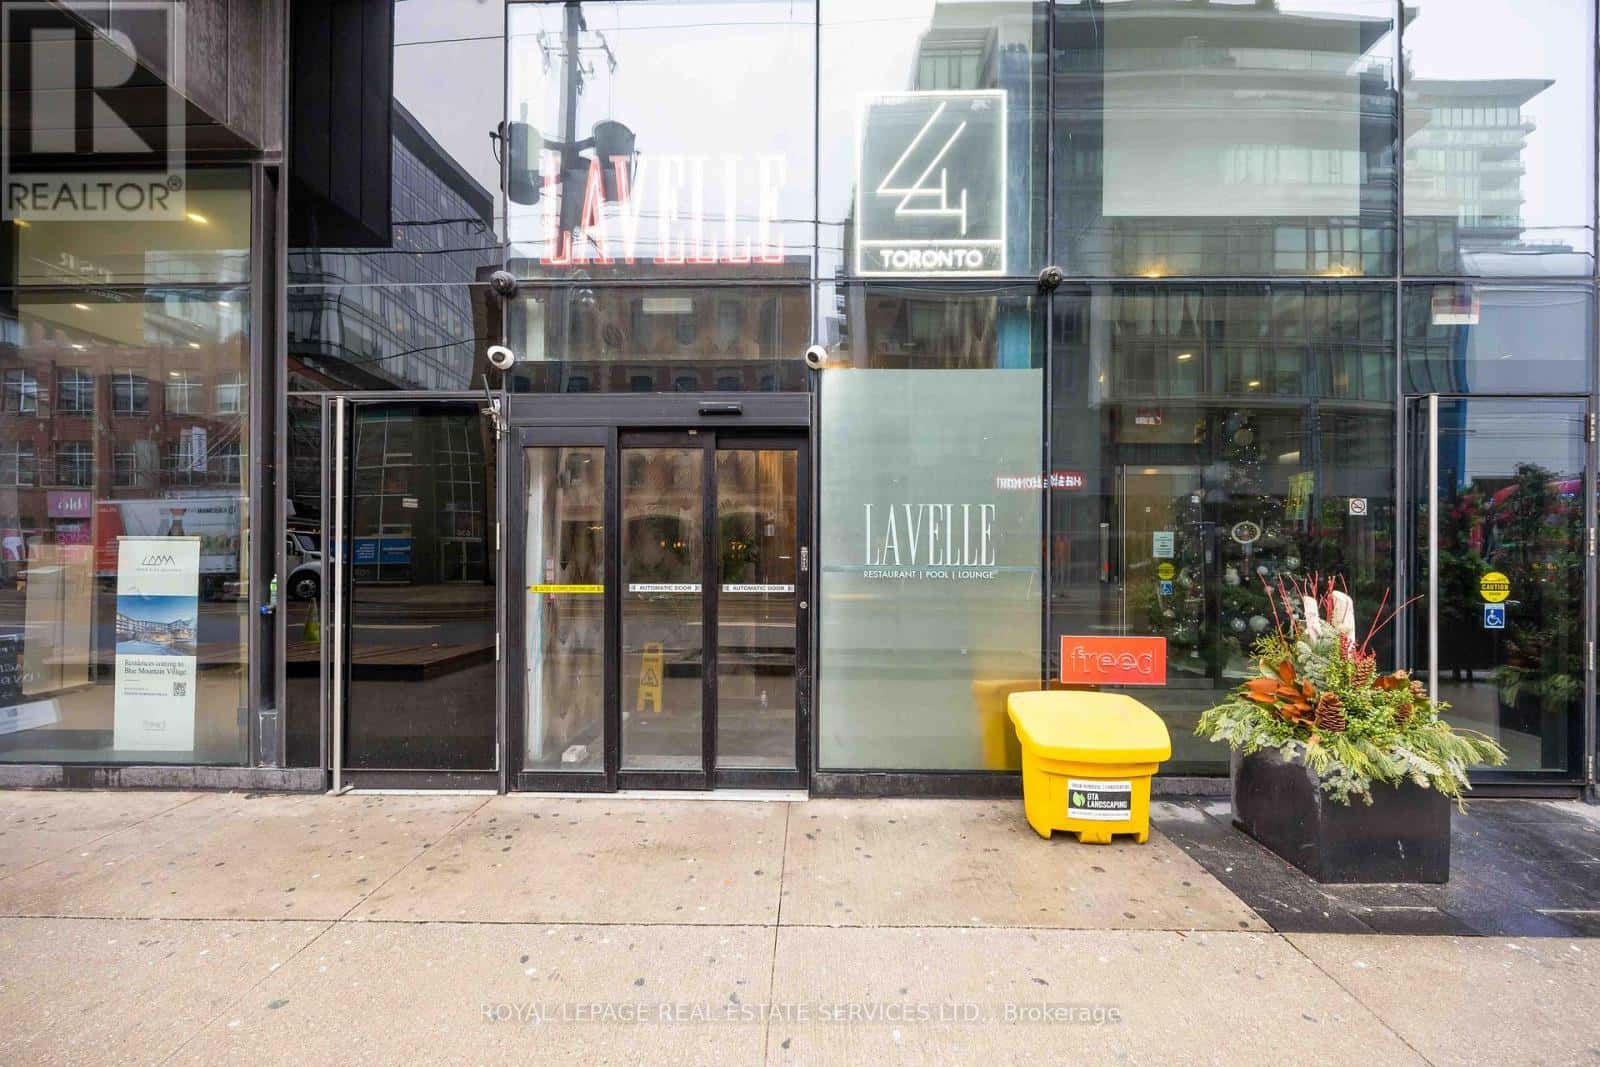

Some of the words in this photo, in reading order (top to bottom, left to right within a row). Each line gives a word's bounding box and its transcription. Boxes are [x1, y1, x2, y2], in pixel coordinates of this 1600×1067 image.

[539, 152, 788, 266] LAVELLE
[879, 249, 983, 269] TORONTO
[863, 503, 996, 567] LAVELLE
[863, 570, 917, 579] RESTAURANT
[925, 570, 949, 579] POOL
[958, 570, 994, 579] LOUNGE
[1481, 583, 1509, 591] CAUTION
[1071, 645, 1157, 675] freed
[124, 666, 137, 674] Blue
[138, 667, 165, 675] Mountain
[1087, 793, 1099, 801] GTA
[1087, 800, 1128, 809] LANDSCAPING
